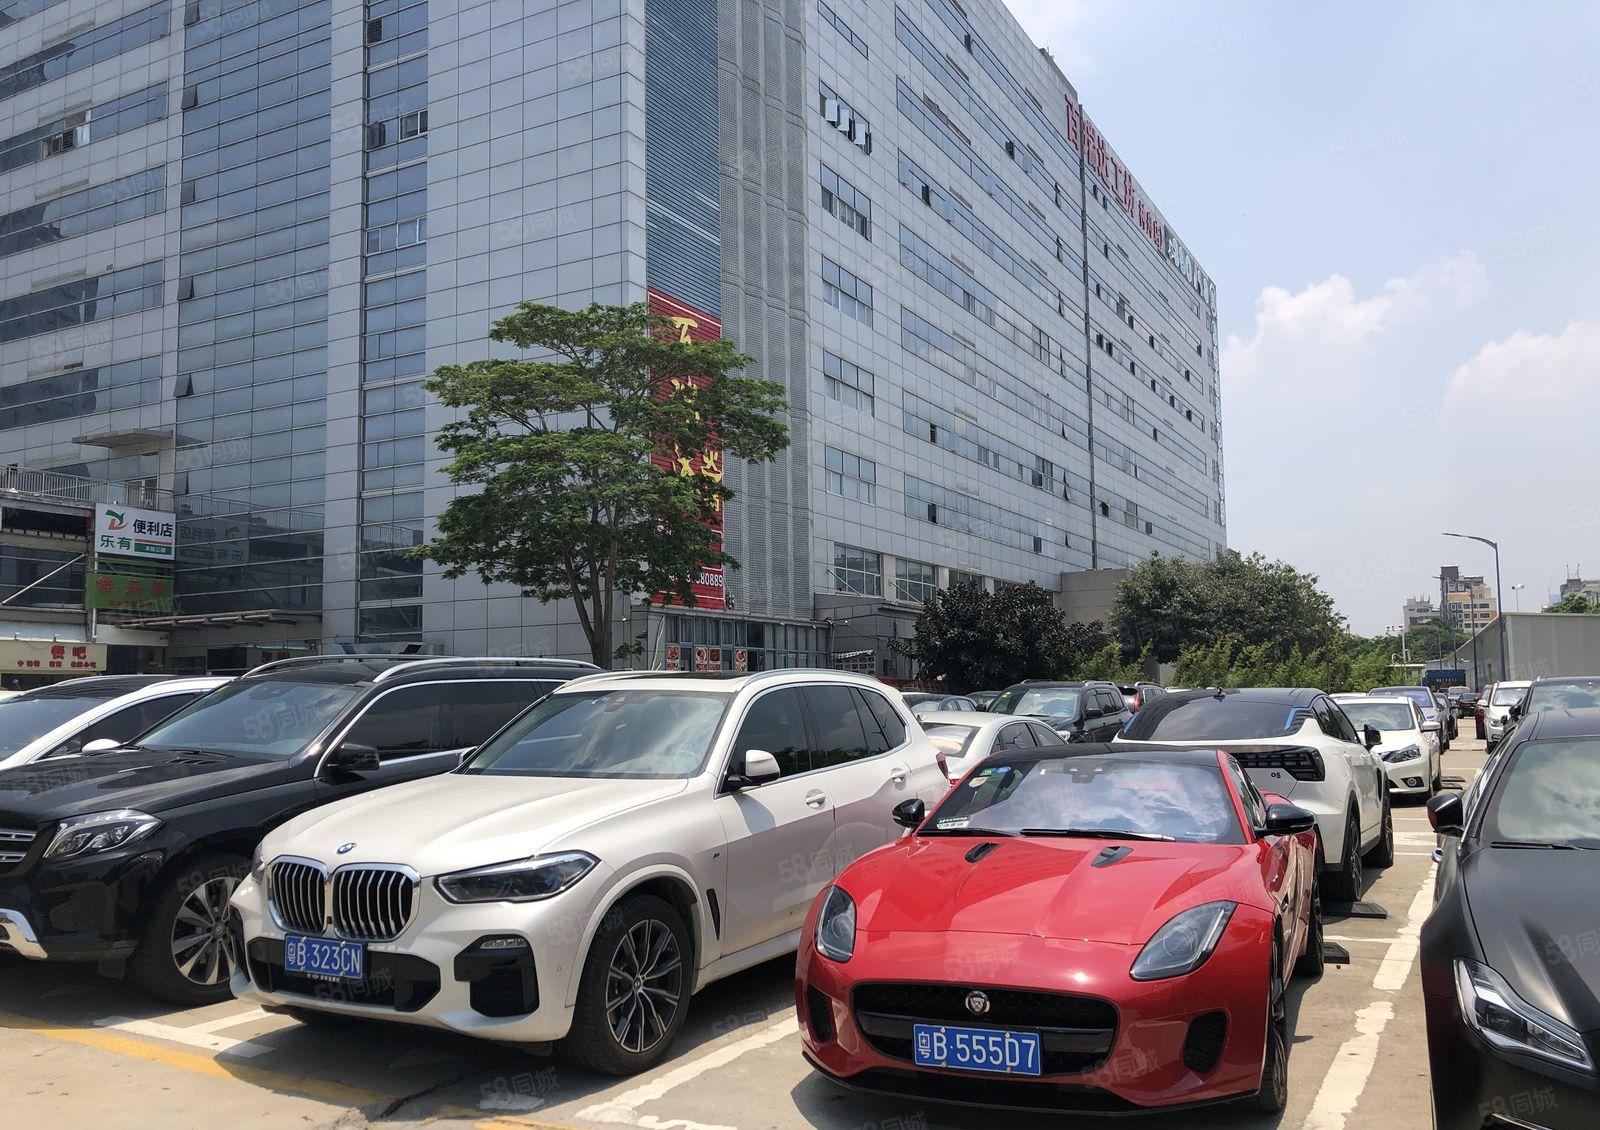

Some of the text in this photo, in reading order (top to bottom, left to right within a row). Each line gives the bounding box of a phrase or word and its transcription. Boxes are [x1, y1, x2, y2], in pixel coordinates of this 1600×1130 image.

[133, 519, 173, 537] 便利店
[100, 535, 132, 550] 乐有
[918, 1031, 1036, 1068] 粤B·555D7
